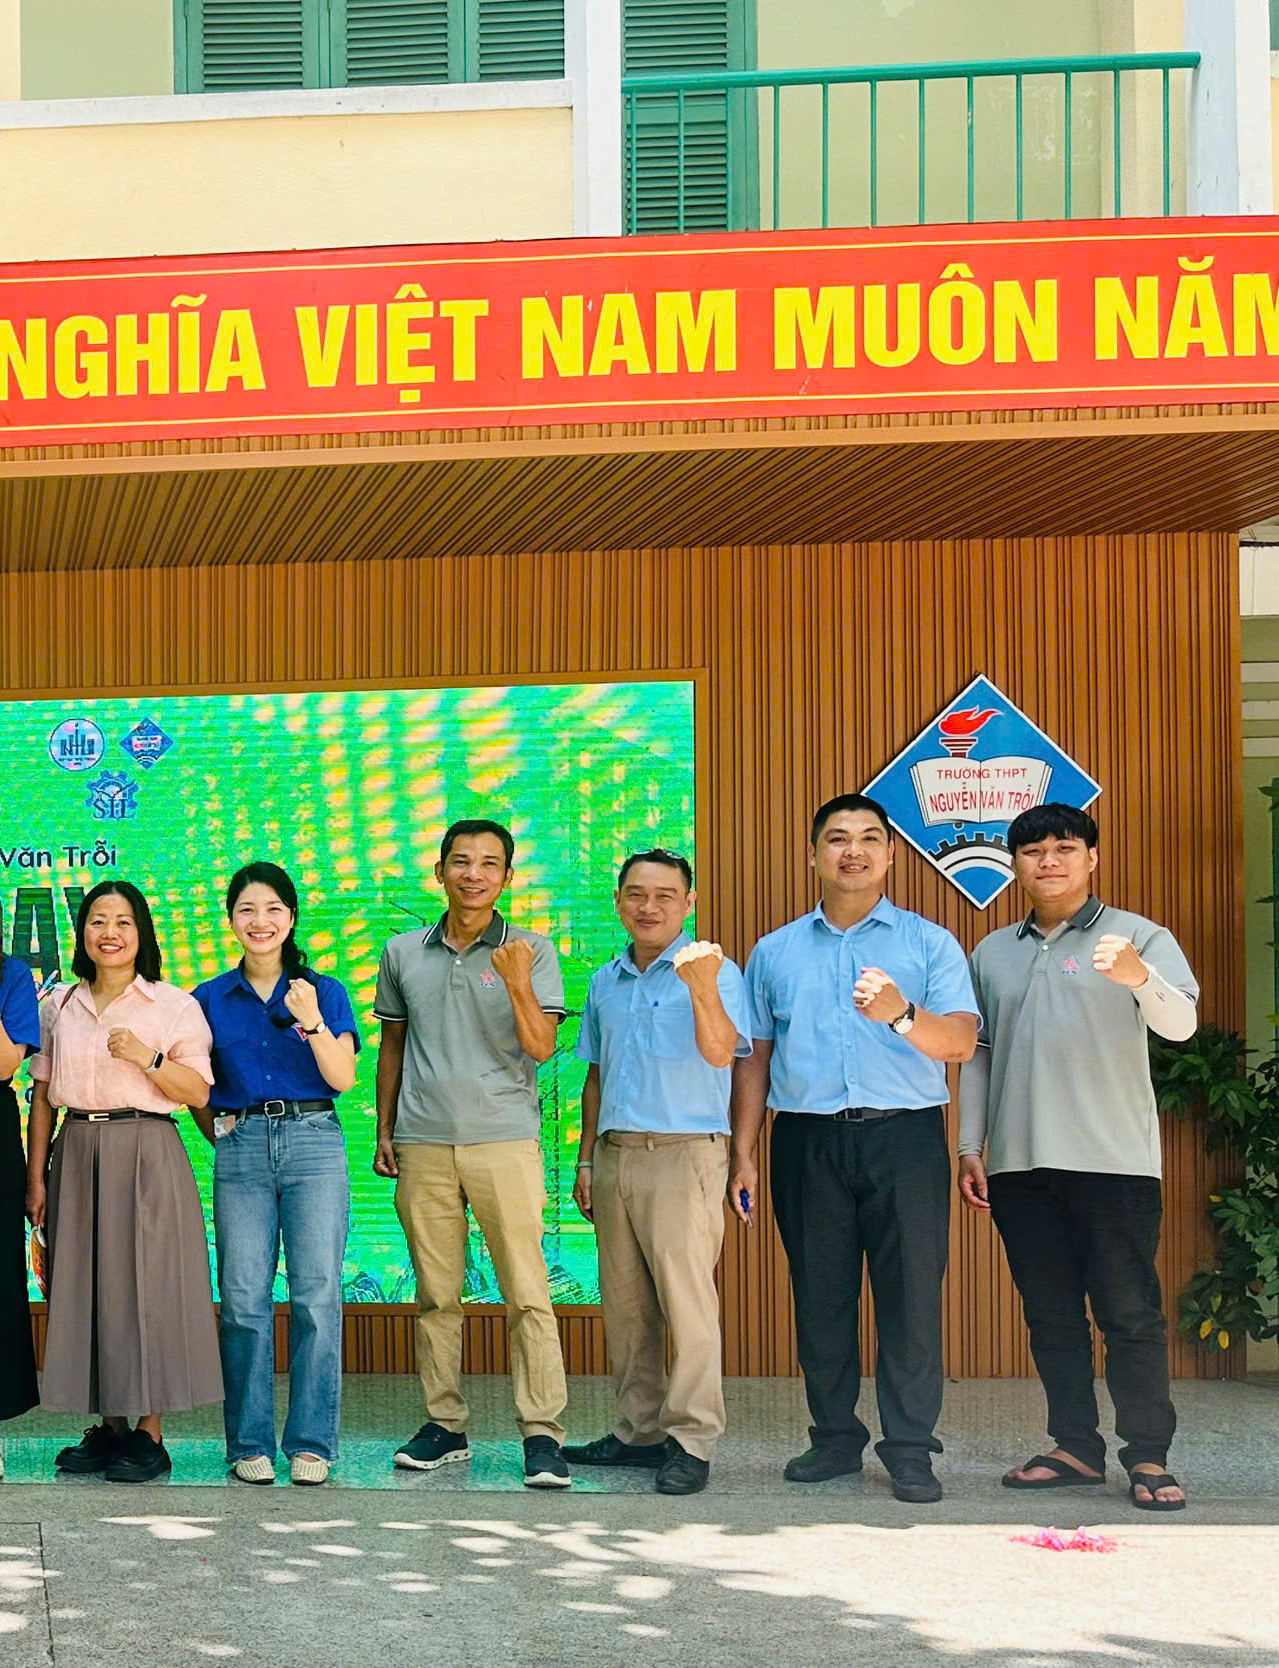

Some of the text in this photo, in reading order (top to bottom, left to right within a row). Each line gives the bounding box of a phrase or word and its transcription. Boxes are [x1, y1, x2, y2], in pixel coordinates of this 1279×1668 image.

[296, 283, 489, 403] VIỆT
[522, 290, 736, 378] NAM
[774, 263, 1057, 369] MUÔN
[1094, 256, 1279, 359] NĂM
[937, 766, 1027, 779] TRƯỜNG THPT
[929, 781, 979, 813] NGUYỄN
[981, 785, 1004, 809] VĂN
[62, 840, 117, 867] Trỗi
